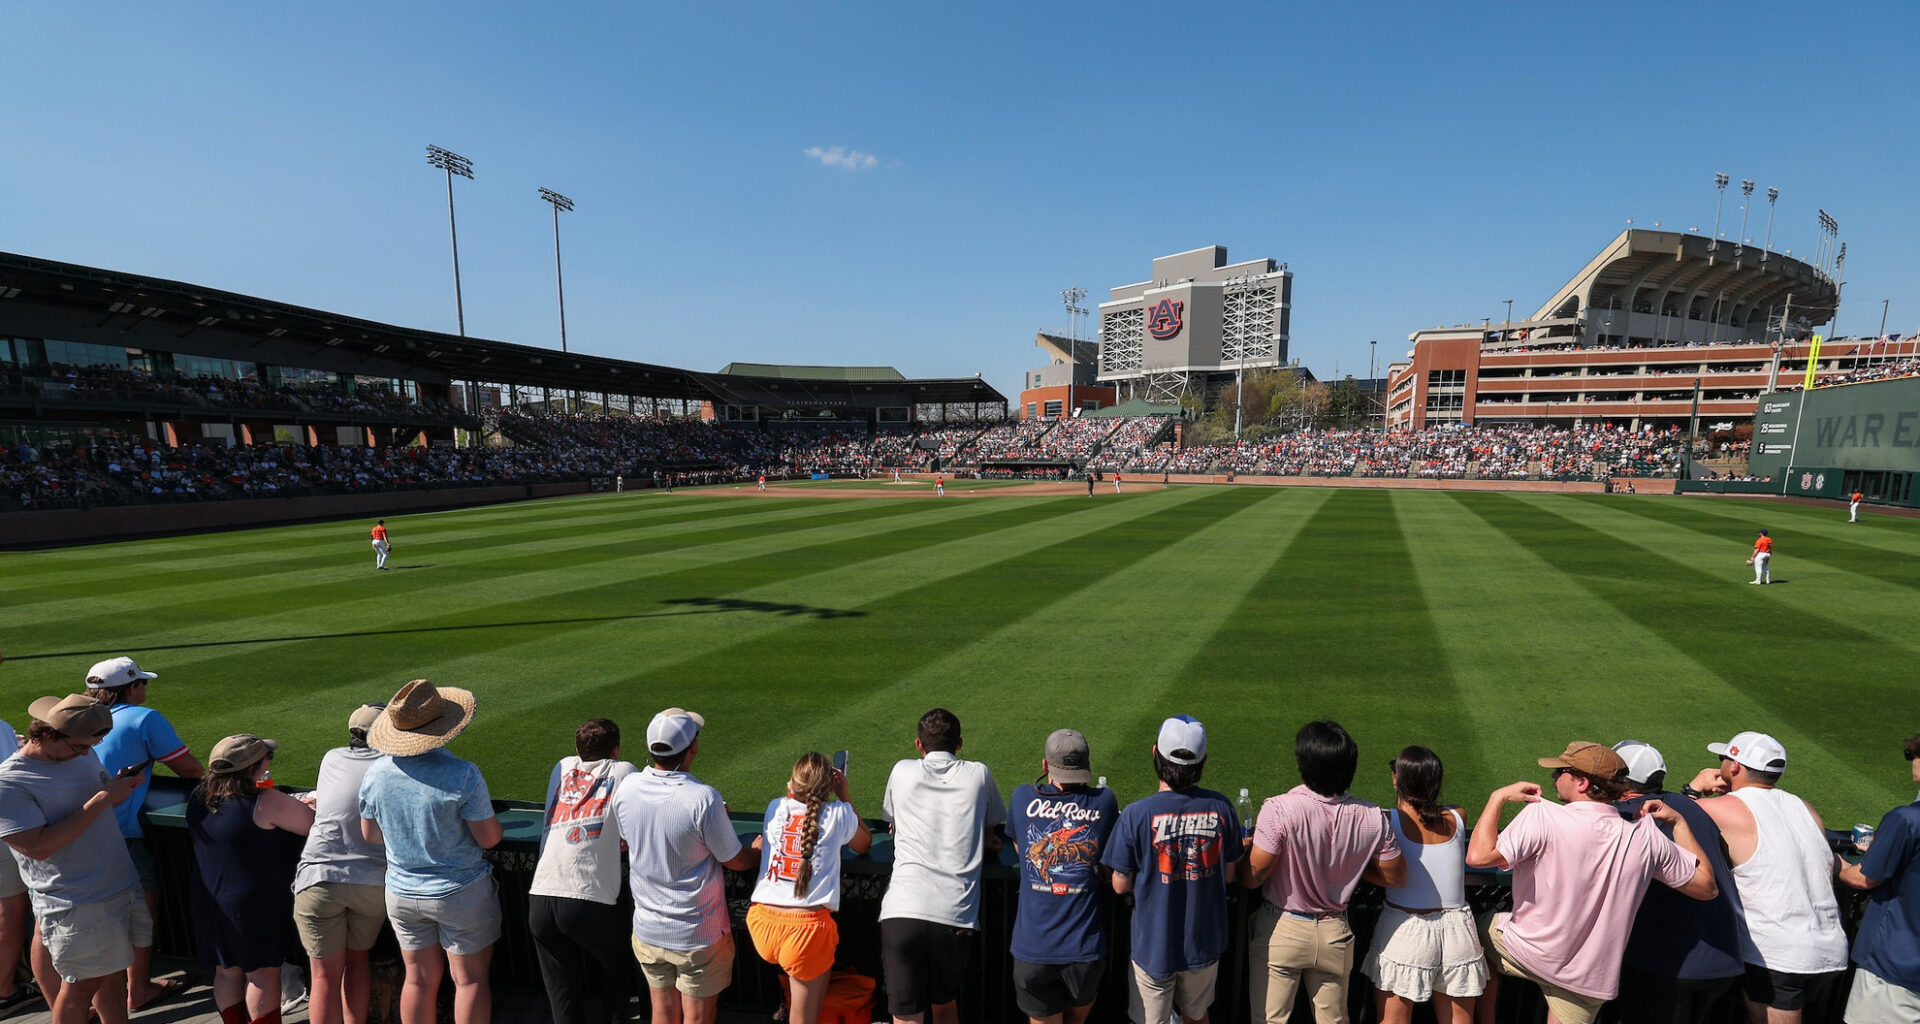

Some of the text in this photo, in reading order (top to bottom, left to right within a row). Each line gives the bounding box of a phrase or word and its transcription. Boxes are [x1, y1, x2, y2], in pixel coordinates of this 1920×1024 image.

[1816, 413, 1885, 448] WAR
[1026, 798, 1101, 822] Old Row
[1152, 811, 1218, 845] TIGERS
